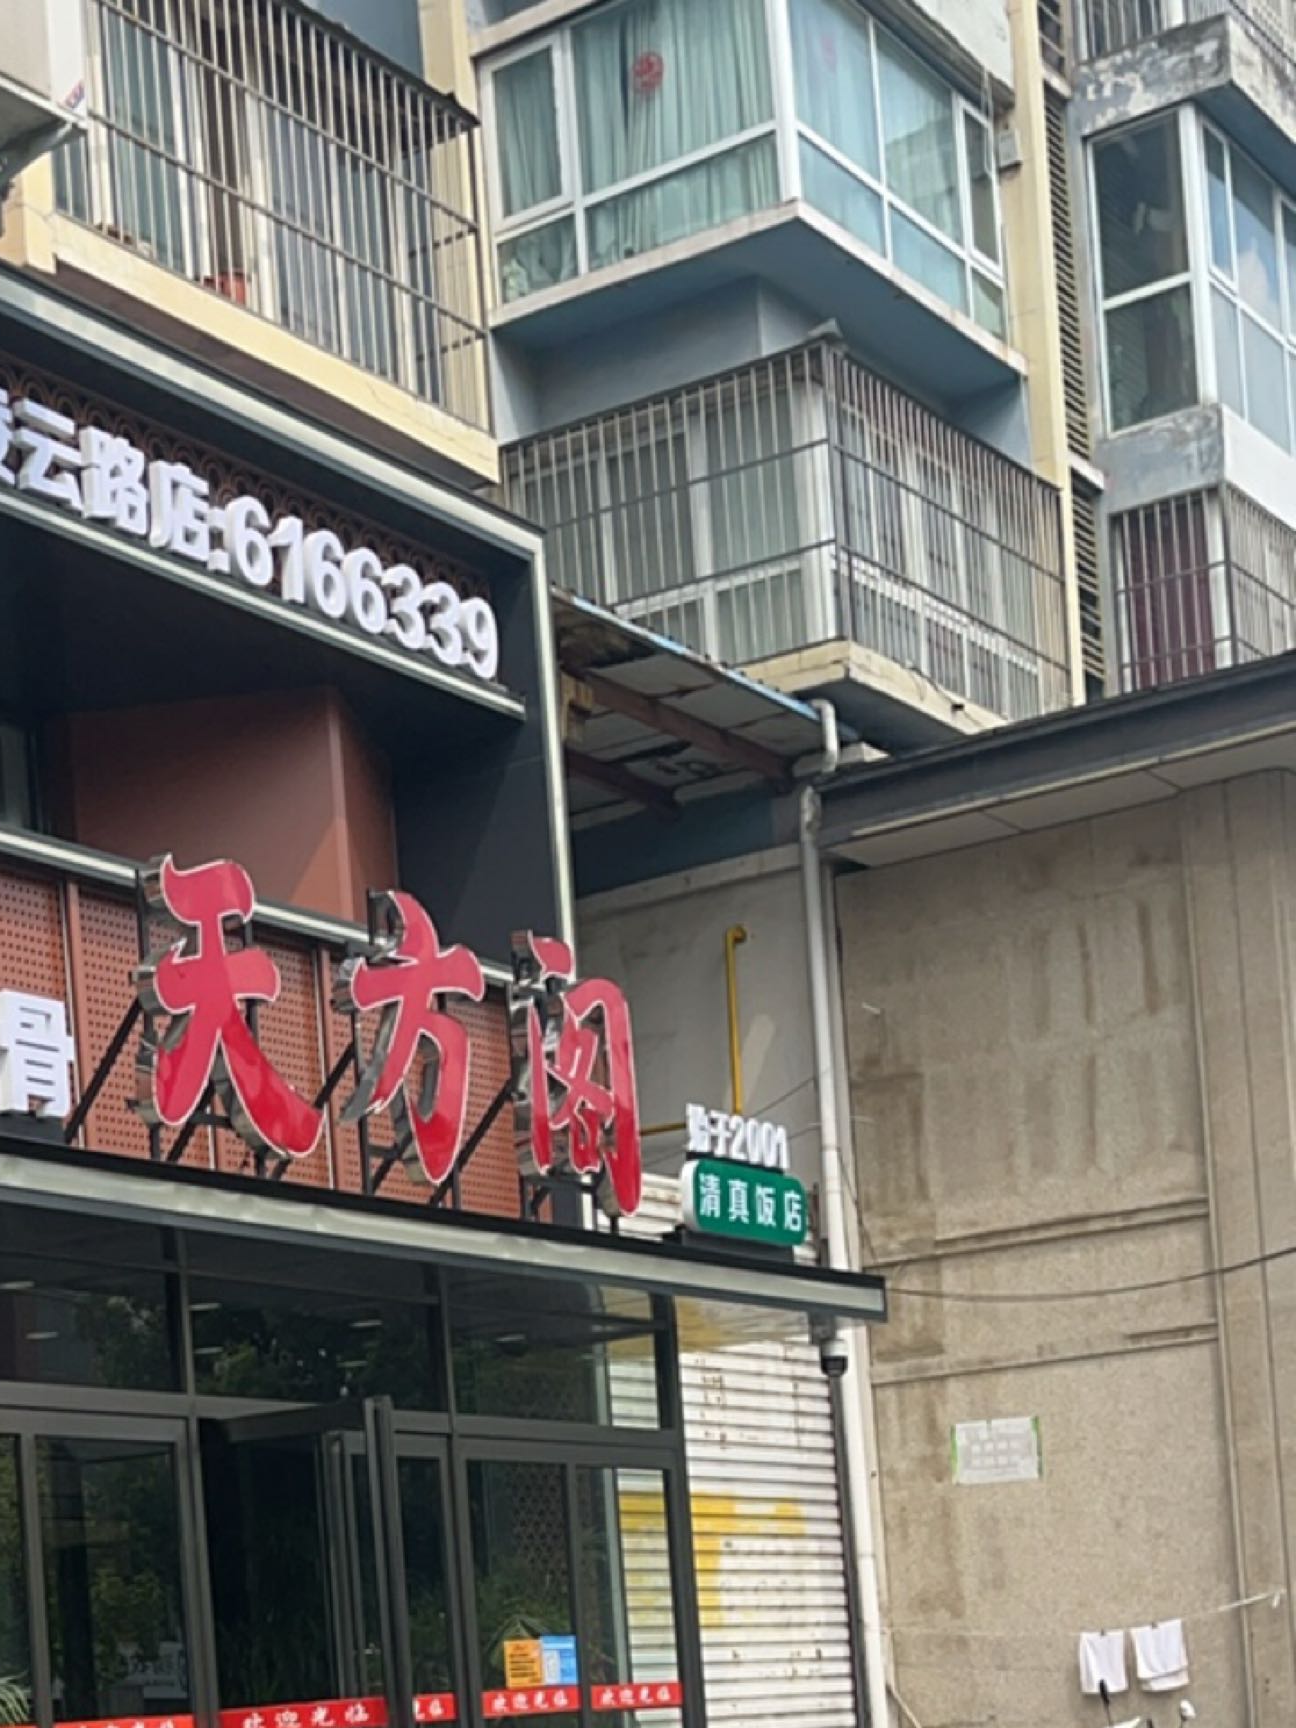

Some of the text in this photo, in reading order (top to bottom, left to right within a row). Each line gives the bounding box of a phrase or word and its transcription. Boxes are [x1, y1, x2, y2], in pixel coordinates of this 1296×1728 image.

[699, 1173, 802, 1232] 清真饭店
[491, 1688, 568, 1712] 欢迎光临
[601, 1684, 670, 1706] 欢迎光临
